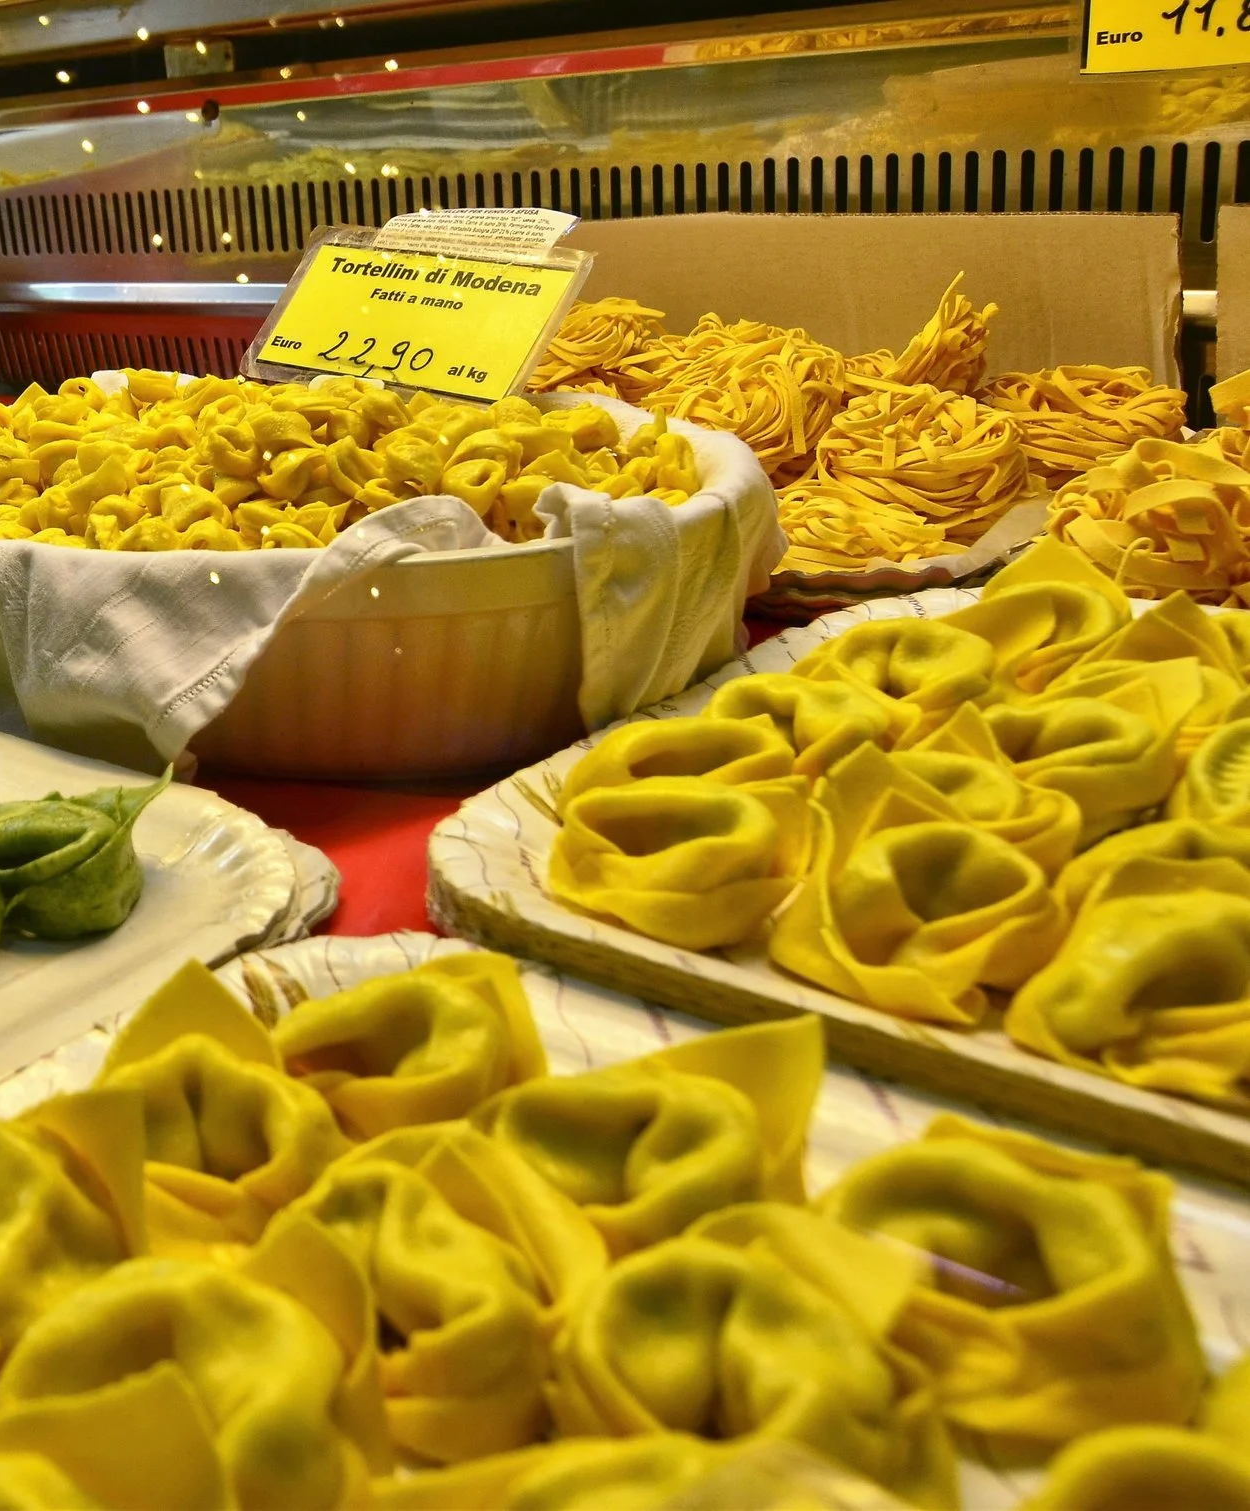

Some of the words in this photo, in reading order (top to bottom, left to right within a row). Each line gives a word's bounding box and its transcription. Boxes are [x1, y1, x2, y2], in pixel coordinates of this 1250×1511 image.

[1096, 31, 1143, 45] Euro
[331, 257, 420, 281] Tortellini
[424, 268, 449, 284] di
[450, 270, 542, 297] Modena
[370, 288, 405, 302] Fatti
[407, 294, 418, 304] a
[420, 296, 464, 310] mano
[271, 335, 302, 350] Euro
[318, 331, 434, 377] 22,90
[447, 365, 463, 377] al
[466, 366, 488, 383] kg
